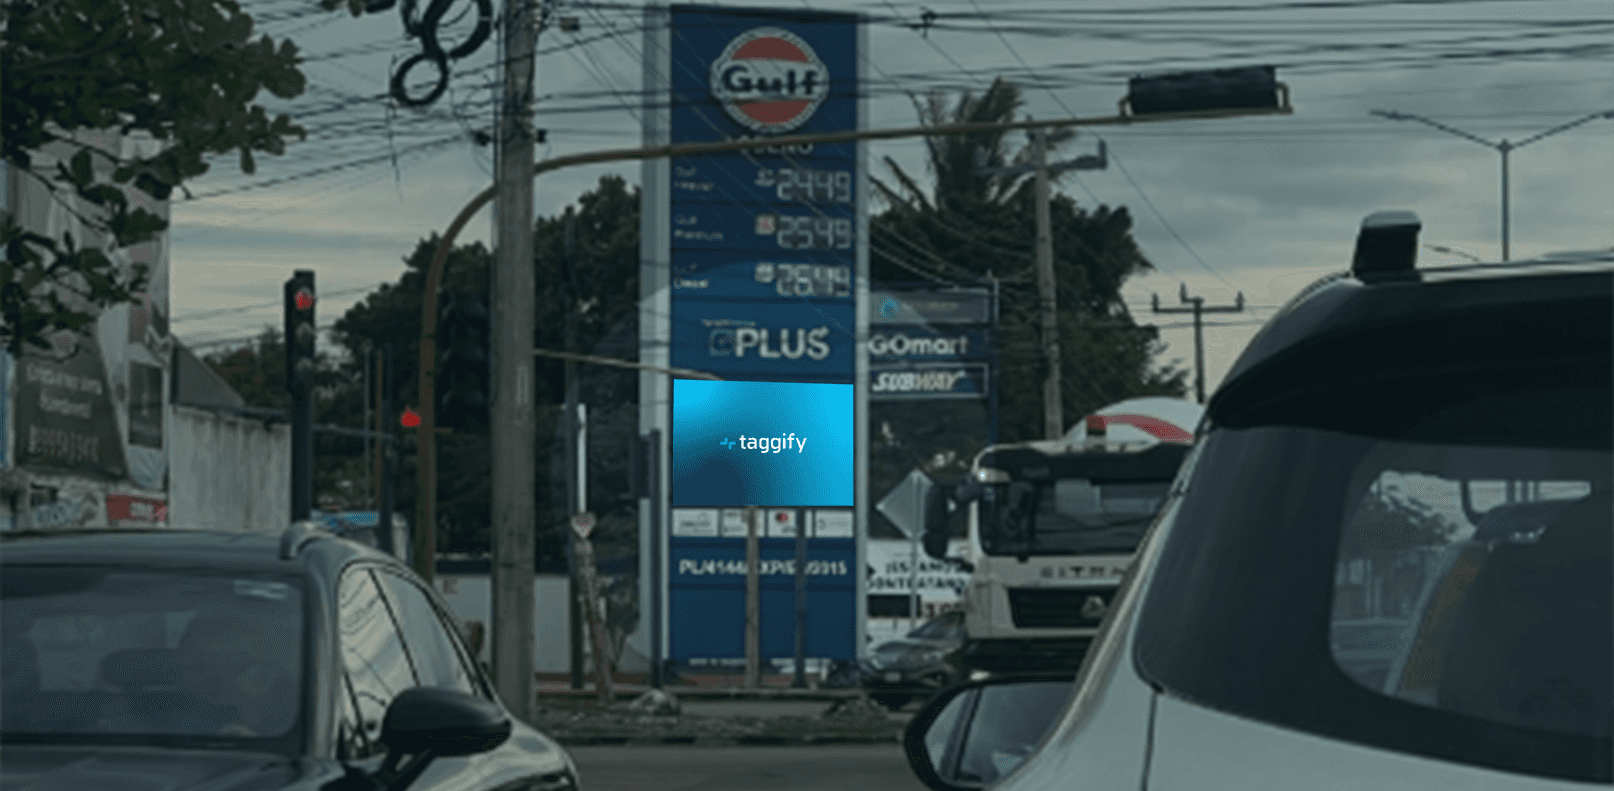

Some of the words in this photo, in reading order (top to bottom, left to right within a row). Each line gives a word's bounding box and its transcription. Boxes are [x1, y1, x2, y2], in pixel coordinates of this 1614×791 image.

[721, 65, 818, 96] Gulf
[735, 327, 829, 361] PLUS
[868, 333, 968, 356] GOmart
[739, 433, 808, 454] taggify
